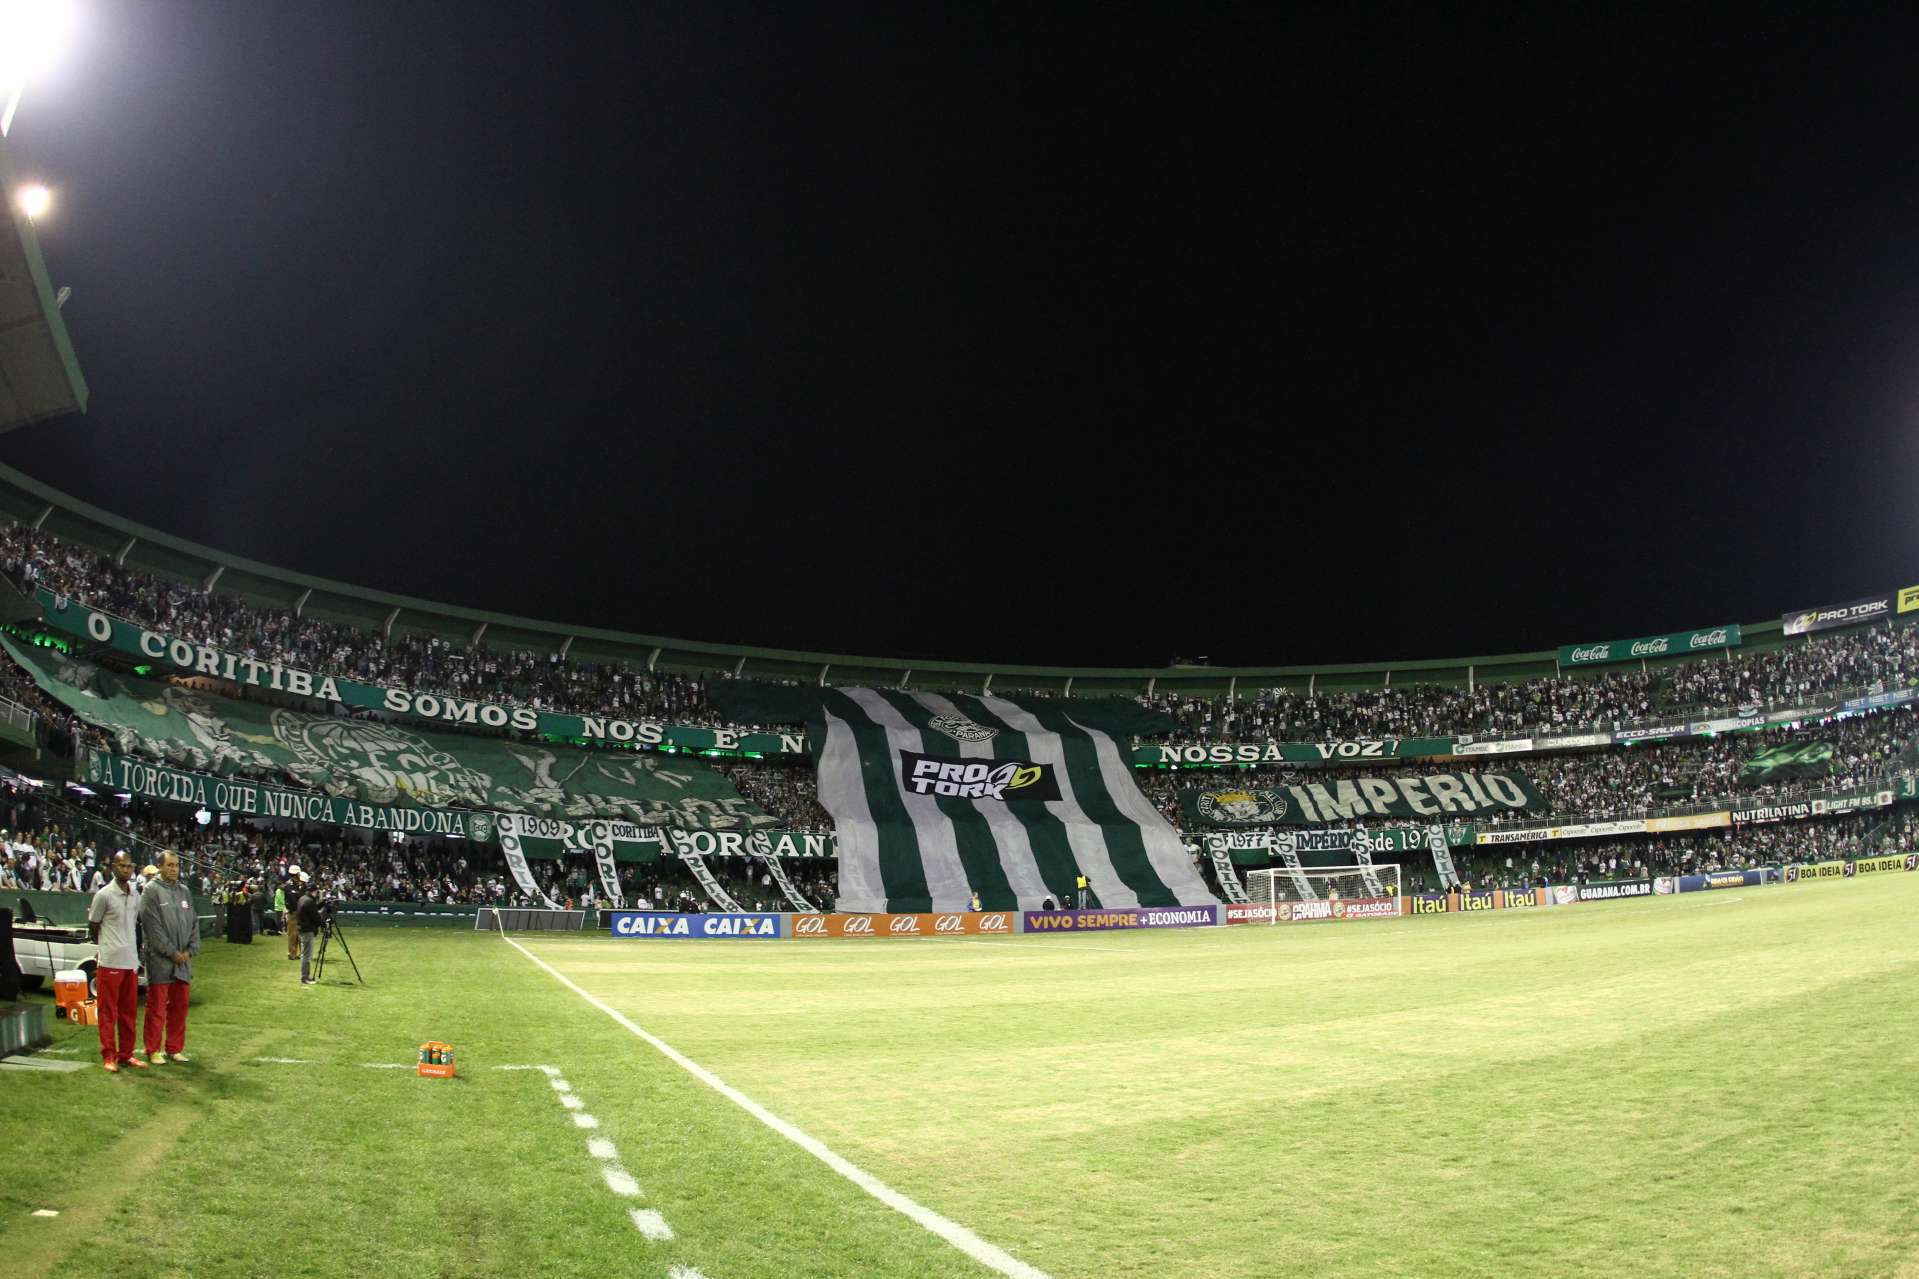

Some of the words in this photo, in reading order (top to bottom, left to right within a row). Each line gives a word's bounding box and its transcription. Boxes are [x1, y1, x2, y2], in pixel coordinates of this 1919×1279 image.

[1818, 608, 1847, 622] PRO
[1851, 600, 1888, 615] TORK
[1631, 638, 1669, 655] Coca-Cola
[1690, 630, 1728, 648] Coca-Cola
[1571, 645, 1610, 662] Coca-Cola
[88, 612, 112, 642] O
[140, 631, 342, 702] CORITIBA
[384, 688, 538, 731] SOMOS
[781, 734, 812, 754] N
[1159, 744, 1284, 764] NOSSA
[913, 759, 989, 783] PRO
[102, 755, 115, 786] A
[120, 760, 207, 806] TORCIDA
[215, 782, 257, 814] QUE
[264, 790, 337, 823] NUNCA
[343, 802, 466, 835] ABANDONA
[911, 777, 1005, 800] TORK
[1732, 803, 1810, 822] NUTRILATINA
[1827, 800, 1847, 810] LIGHT
[1849, 799, 1860, 808] FM
[519, 815, 561, 837] 1909
[611, 824, 660, 839] CORITIBA
[1231, 834, 1265, 848] 1977
[1295, 830, 1351, 850] IMPÉRIO
[1490, 830, 1548, 843] TRANSAMÉRICA
[1844, 863, 1856, 877] 51
[1859, 862, 1877, 873] BOA
[1879, 859, 1902, 871] IDEIA
[1905, 856, 1918, 868] 51
[1786, 867, 1798, 882] 51
[1800, 868, 1817, 879] BOA
[1819, 866, 1841, 878] IDEIA
[1504, 889, 1535, 908] Itaú
[1580, 883, 1651, 900] GUARANA.COM.BR
[1413, 895, 1447, 914] Itaú
[1460, 892, 1492, 911] Itaú
[617, 917, 690, 935] CAIXA
[704, 917, 775, 935] CAIXA
[795, 917, 828, 933] GOL
[843, 917, 875, 932] GOL
[889, 916, 921, 932] GOL
[934, 915, 966, 931] GOL
[979, 914, 1009, 930] GOL
[1029, 915, 1073, 929] VIVO
[1077, 913, 1138, 928] SEMPRE
